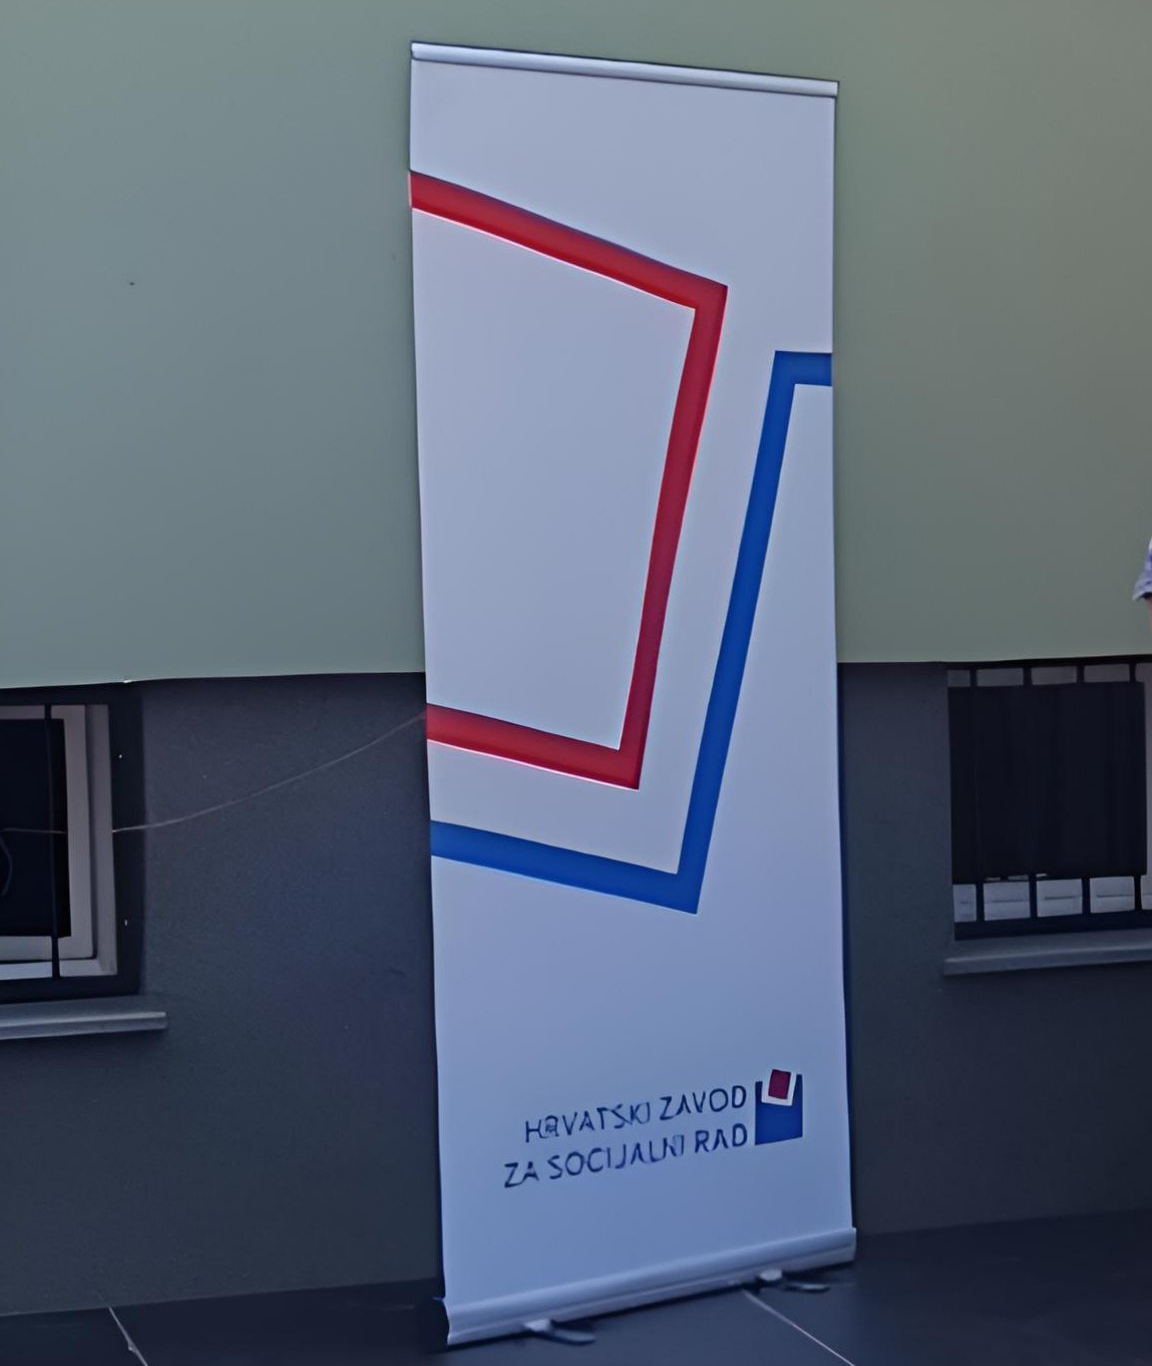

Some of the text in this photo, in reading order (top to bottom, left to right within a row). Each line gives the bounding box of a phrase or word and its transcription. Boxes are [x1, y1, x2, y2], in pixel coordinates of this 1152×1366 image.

[524, 1085, 747, 1143] HRVATSKI ZAVOD
[504, 1123, 748, 1188] ZA SOCIJALNI RAD
